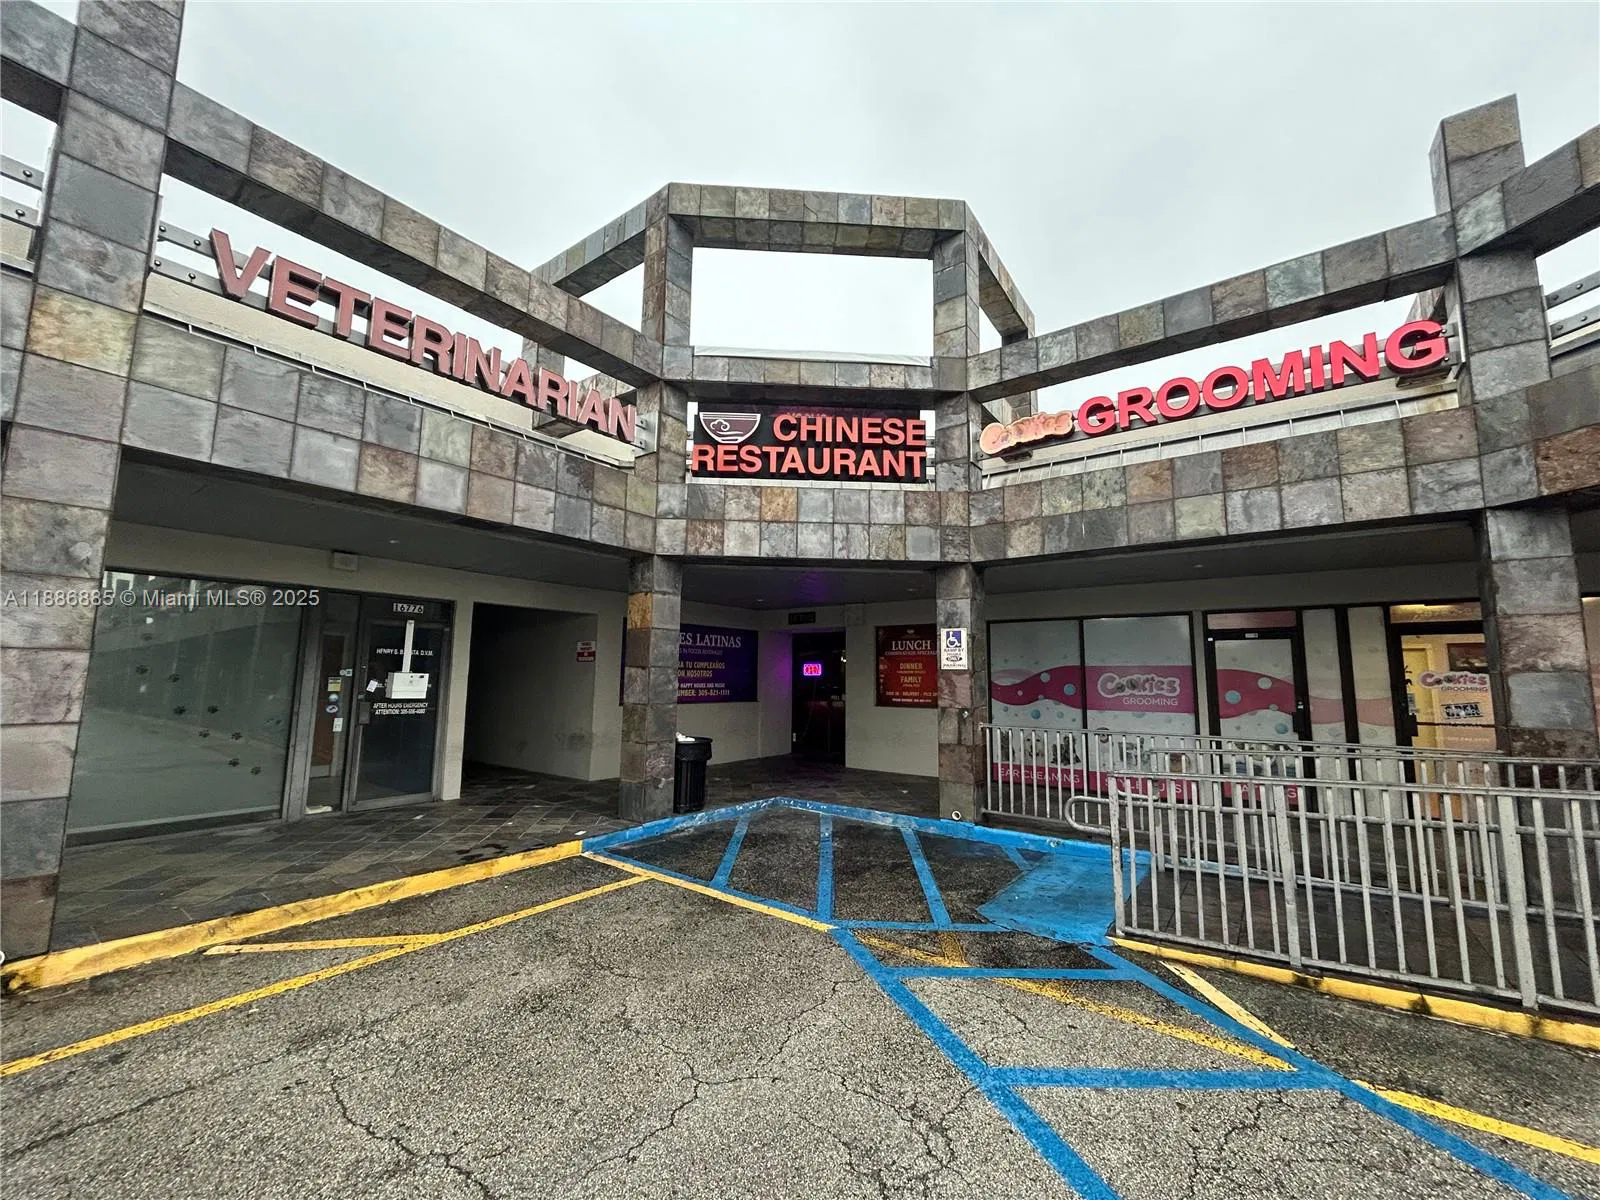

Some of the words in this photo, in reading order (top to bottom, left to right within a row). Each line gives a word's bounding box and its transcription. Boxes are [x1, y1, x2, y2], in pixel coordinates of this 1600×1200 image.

[209, 228, 636, 443] VETERINARIAN
[1077, 319, 1448, 436] GROOMING
[773, 414, 926, 446] CHINESE
[691, 444, 927, 478] RESTAURANT
[696, 633, 742, 648] LATINAS
[892, 640, 931, 651] LUNCH
[900, 662, 923, 670] DINNER
[1098, 672, 1181, 698] Cookies
[1419, 671, 1489, 688] Cookies
[1122, 697, 1178, 706] GROOMING
[1445, 703, 1481, 717] OPEN
